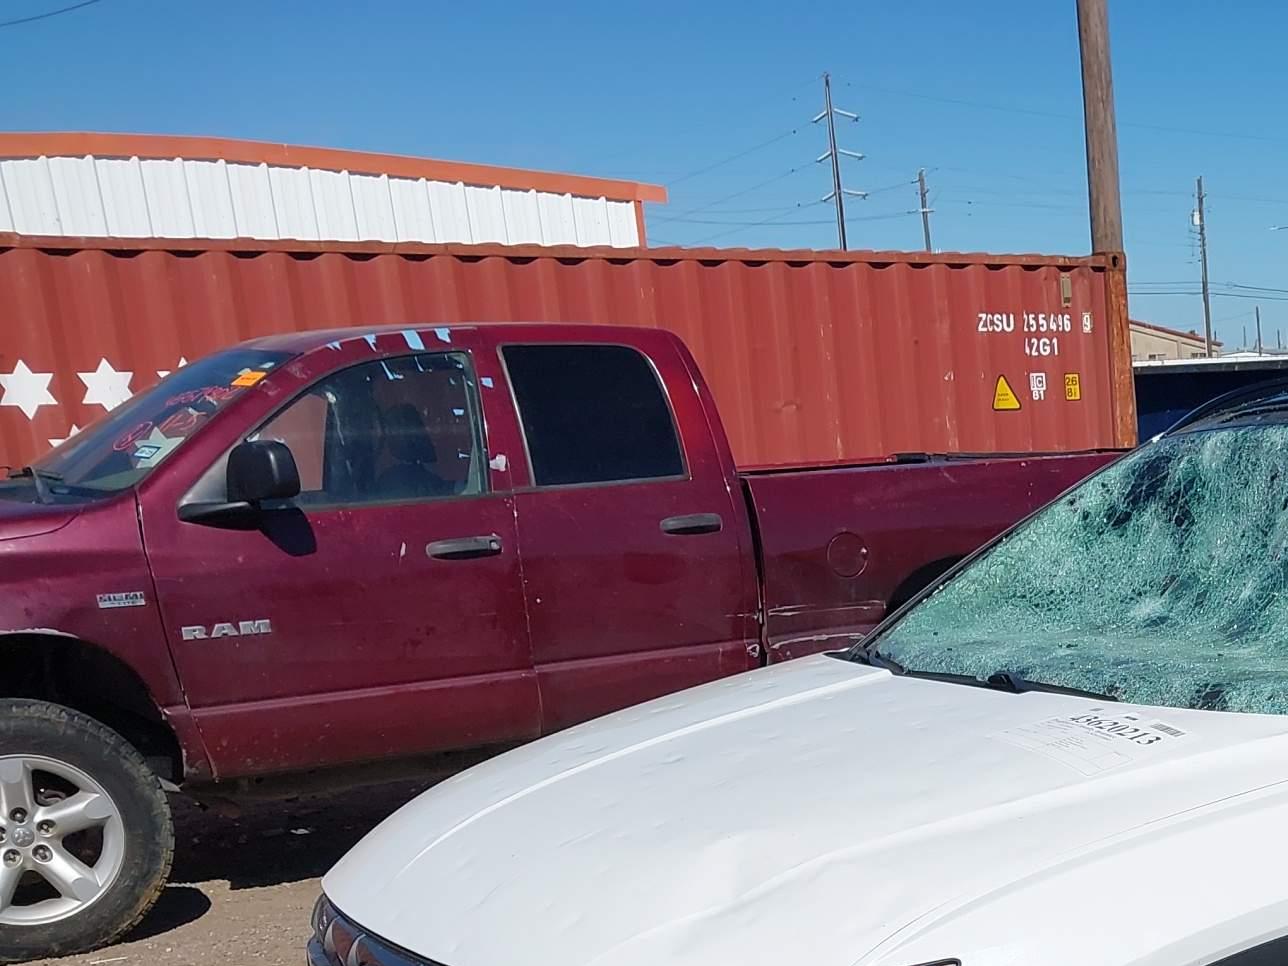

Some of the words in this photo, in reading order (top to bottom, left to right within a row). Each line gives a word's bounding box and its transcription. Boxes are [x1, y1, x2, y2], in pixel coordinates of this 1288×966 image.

[978, 313, 1014, 332] ZCSU
[1023, 312, 1071, 332] 255496
[1025, 337, 1058, 356] 42G1
[181, 619, 272, 641] RAM
